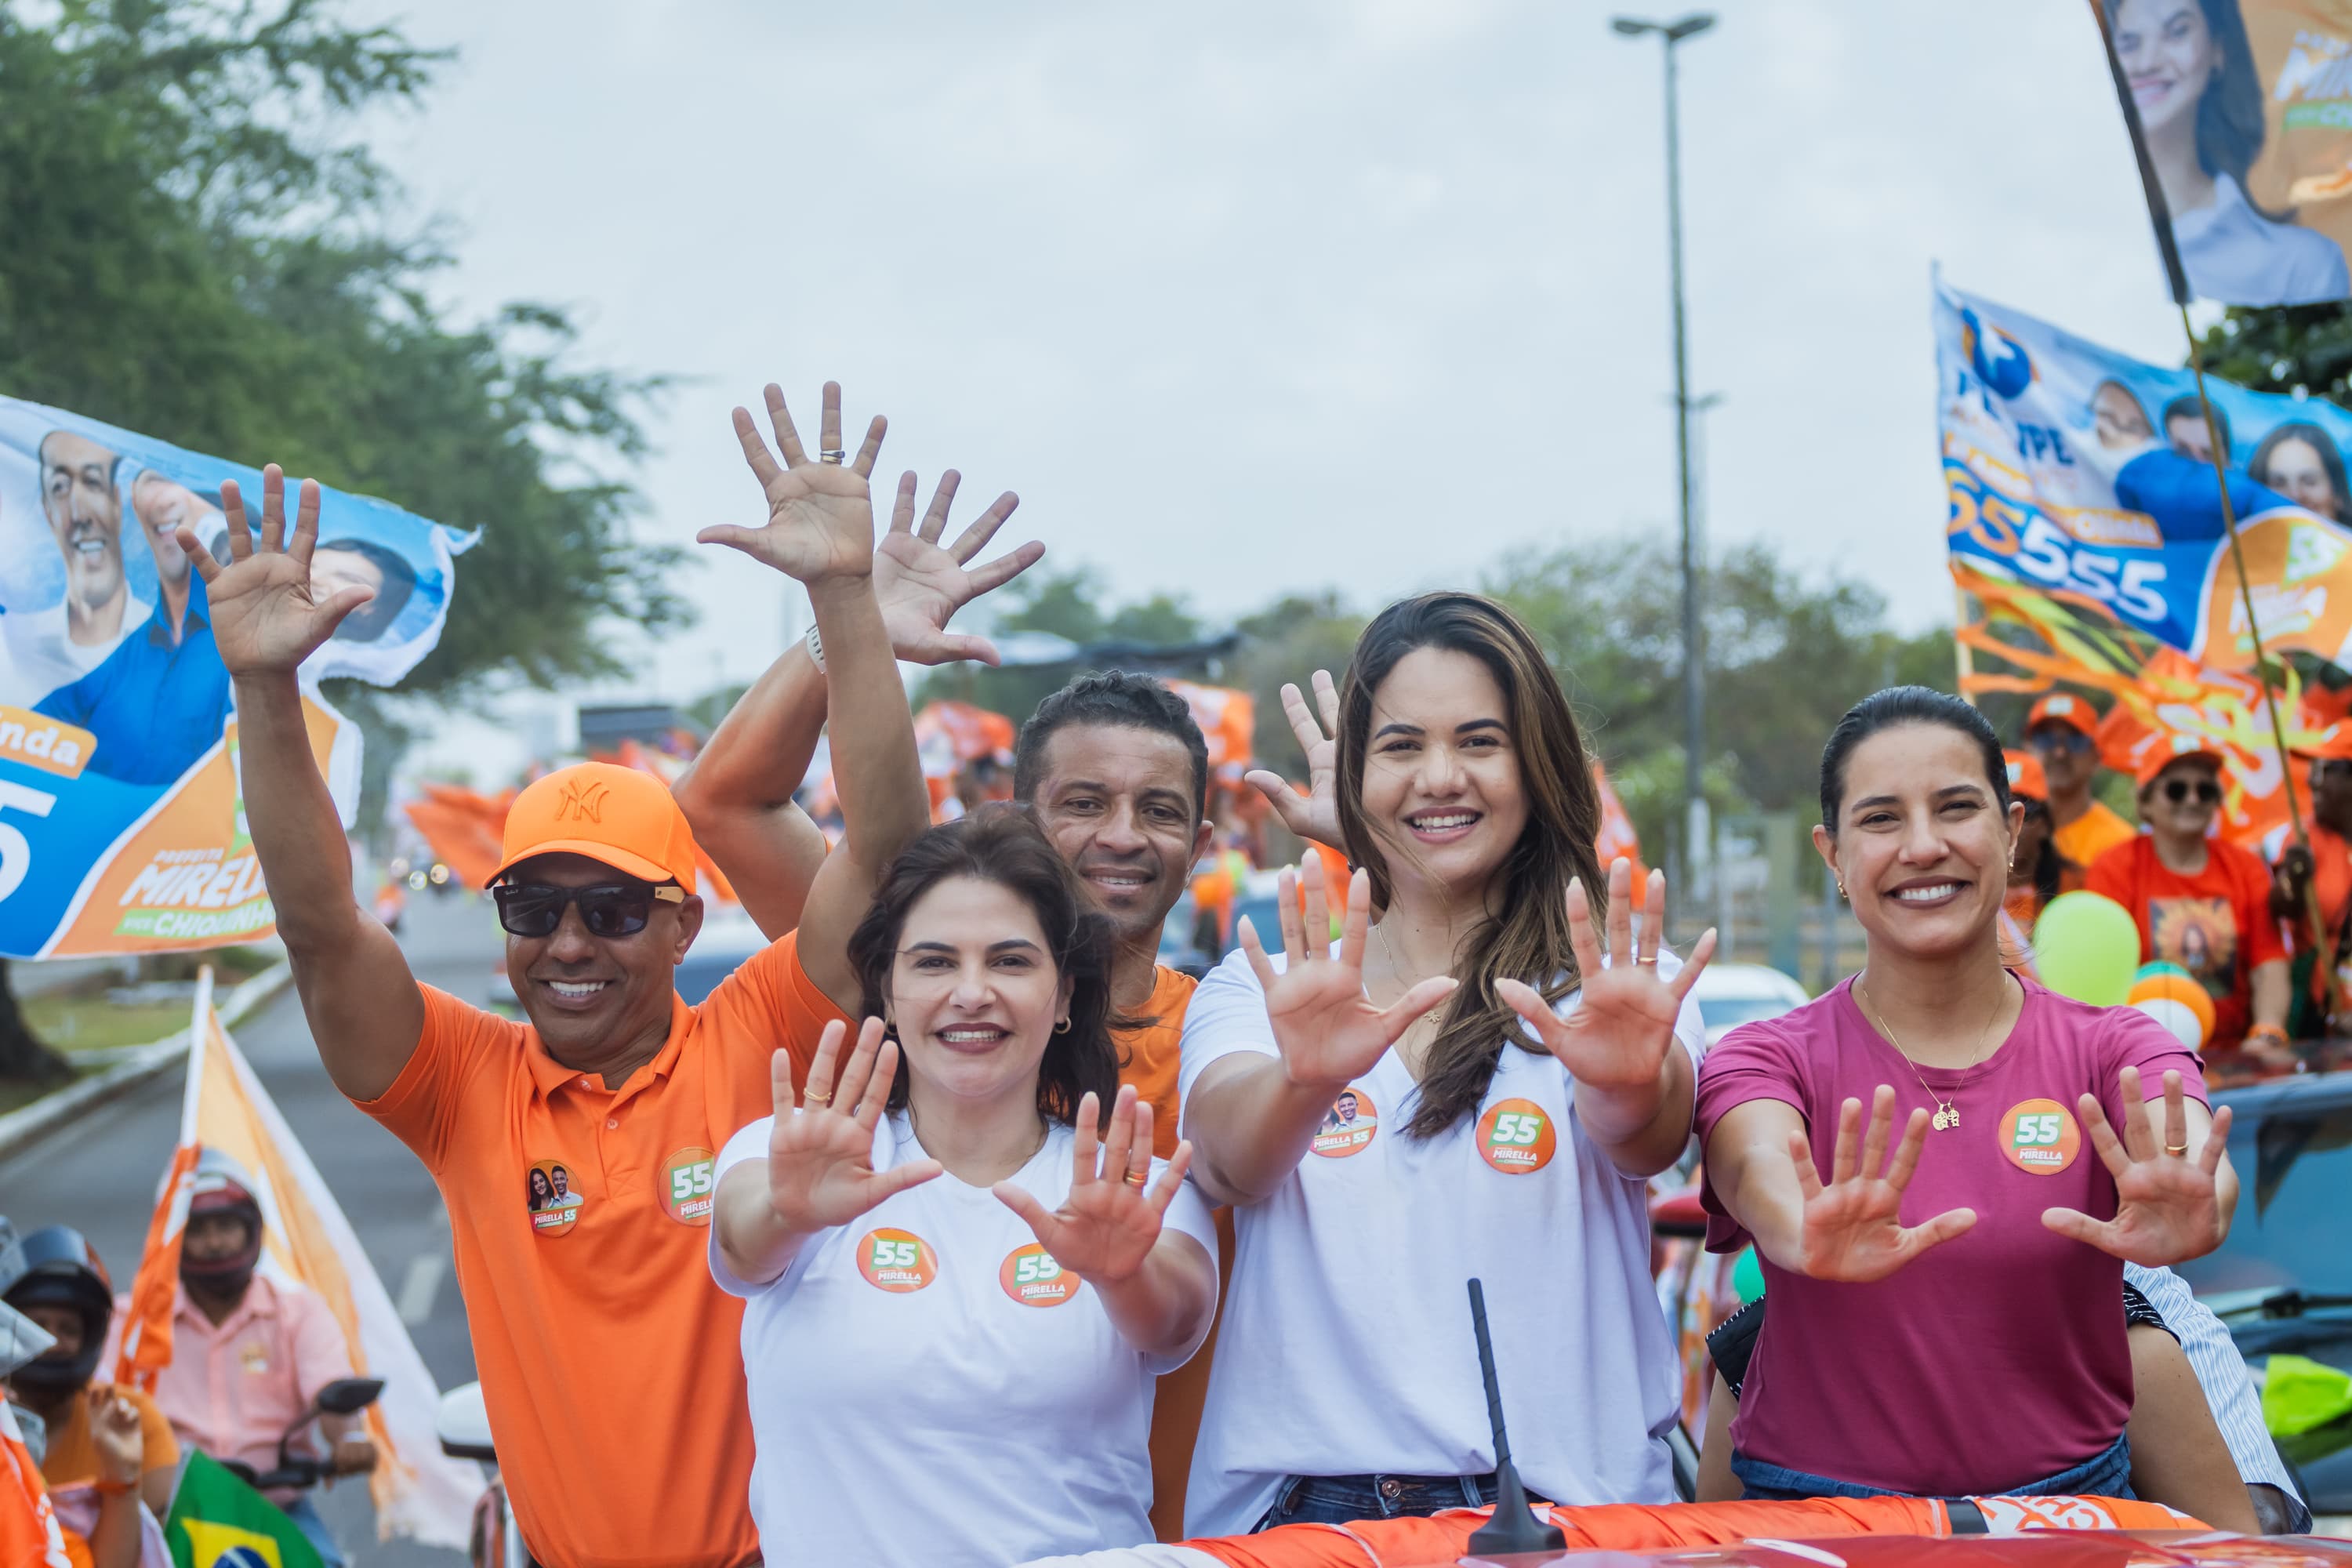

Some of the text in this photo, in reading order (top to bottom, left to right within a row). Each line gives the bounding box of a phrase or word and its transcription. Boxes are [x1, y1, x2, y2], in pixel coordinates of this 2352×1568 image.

[0, 720, 80, 767] nda
[119, 855, 266, 907] MIRELL
[1314, 1136, 1351, 1149] MIRELLA
[1352, 1129, 1369, 1144] 55
[1493, 1114, 1540, 1144] 55
[2016, 1115, 2060, 1144] 55
[1493, 1149, 1537, 1162] MIRELLA
[2019, 1150, 2063, 1161] MIRELLA
[673, 1162, 713, 1199] 55
[535, 1213, 564, 1225] MIRELLA
[564, 1207, 577, 1222] 55
[873, 1240, 916, 1266] 55
[877, 1272, 922, 1281] MIRELLA
[1016, 1254, 1060, 1281] 55
[1021, 1283, 1065, 1297] MIRELLA
